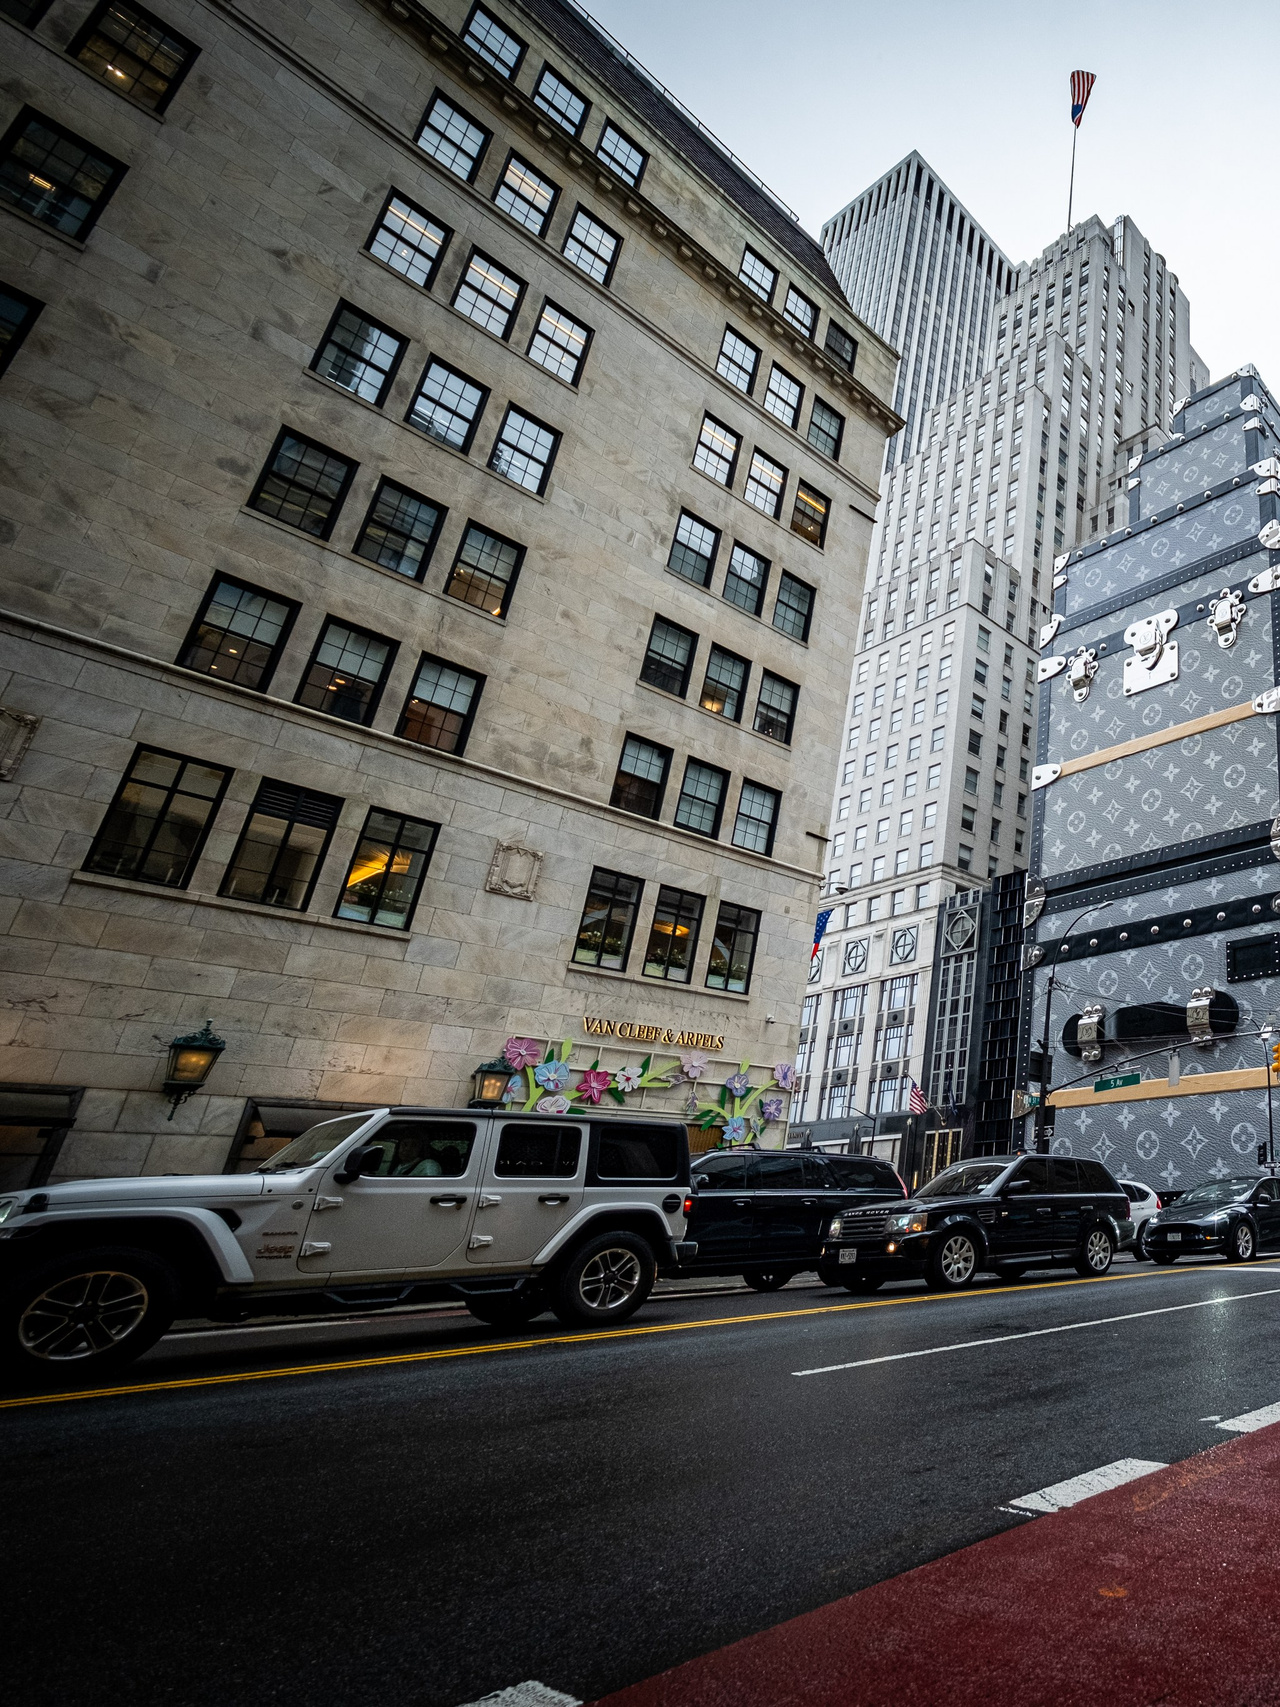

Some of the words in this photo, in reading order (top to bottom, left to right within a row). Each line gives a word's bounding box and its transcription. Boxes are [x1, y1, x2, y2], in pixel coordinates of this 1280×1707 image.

[583, 1016, 616, 1035] VAN
[616, 1022, 662, 1042] CLEEF
[661, 1028, 674, 1044] &
[675, 1031, 725, 1051] ARPELS
